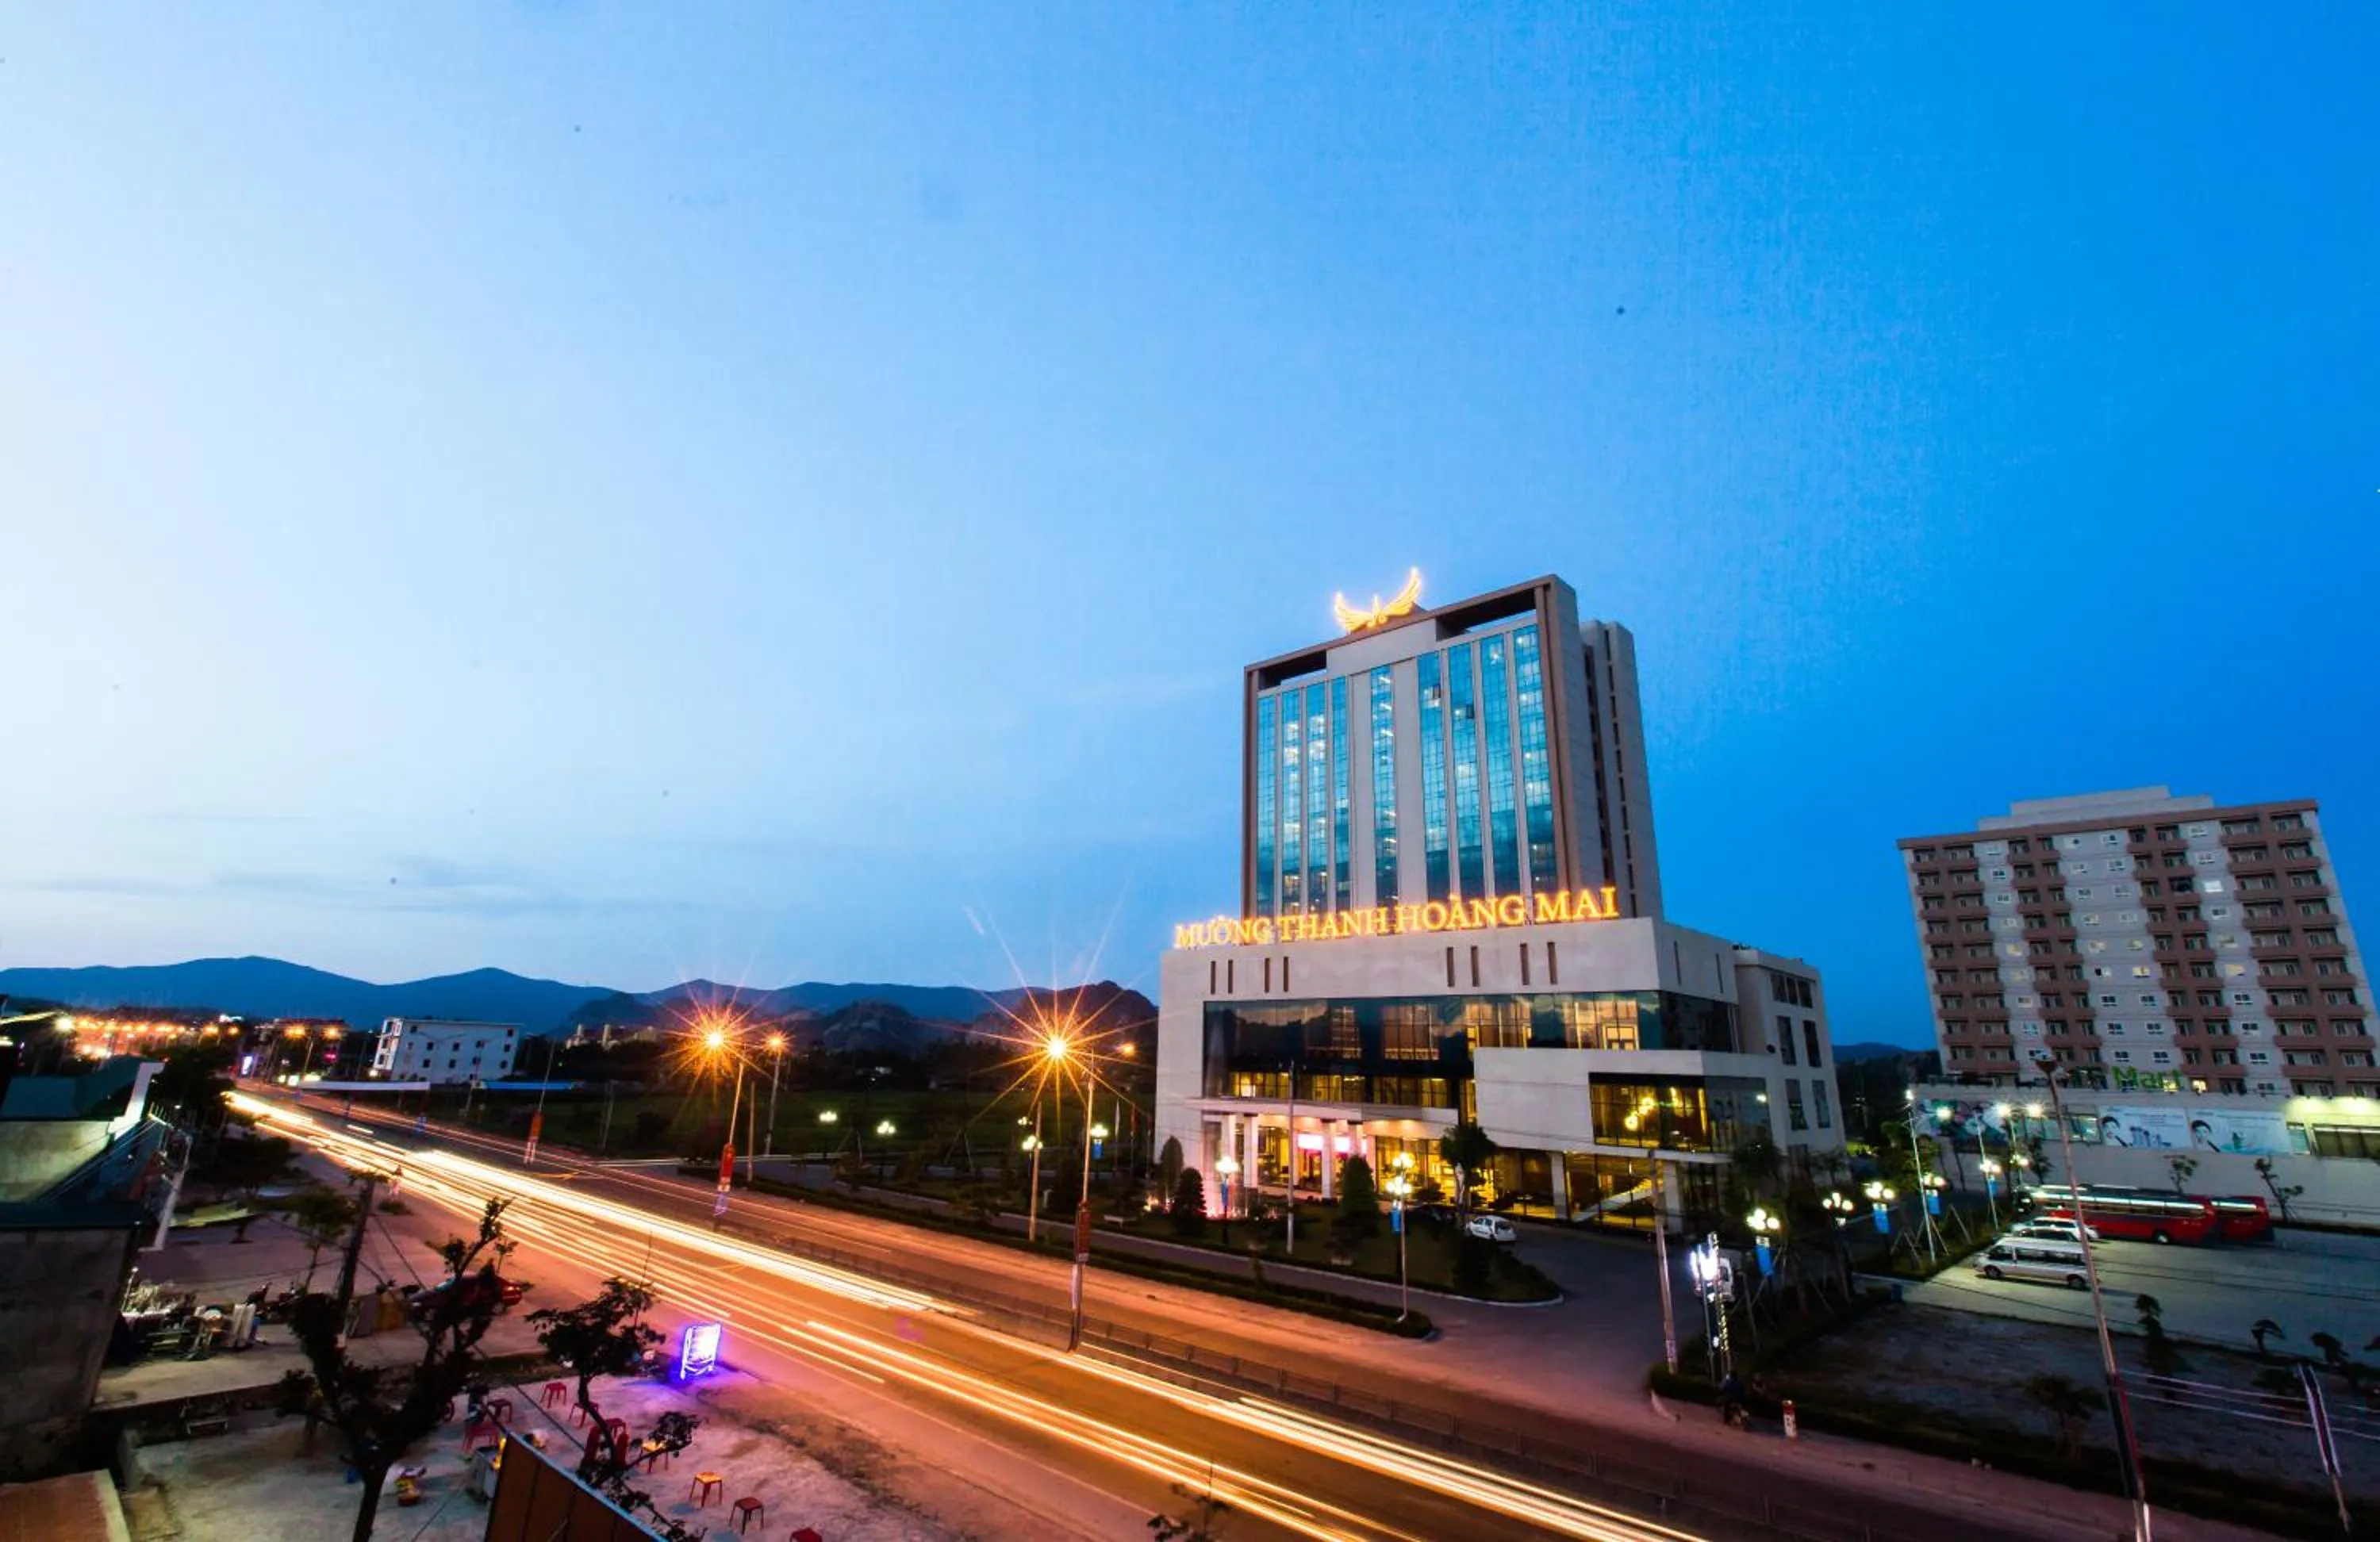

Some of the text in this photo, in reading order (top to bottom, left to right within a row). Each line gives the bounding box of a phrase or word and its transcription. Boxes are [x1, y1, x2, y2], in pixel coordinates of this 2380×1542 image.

[1276, 906, 1389, 942] THANH
[1393, 892, 1526, 934] HOÀNG
[1534, 886, 1619, 923] MAI
[2111, 1065, 2183, 1090] Mart
